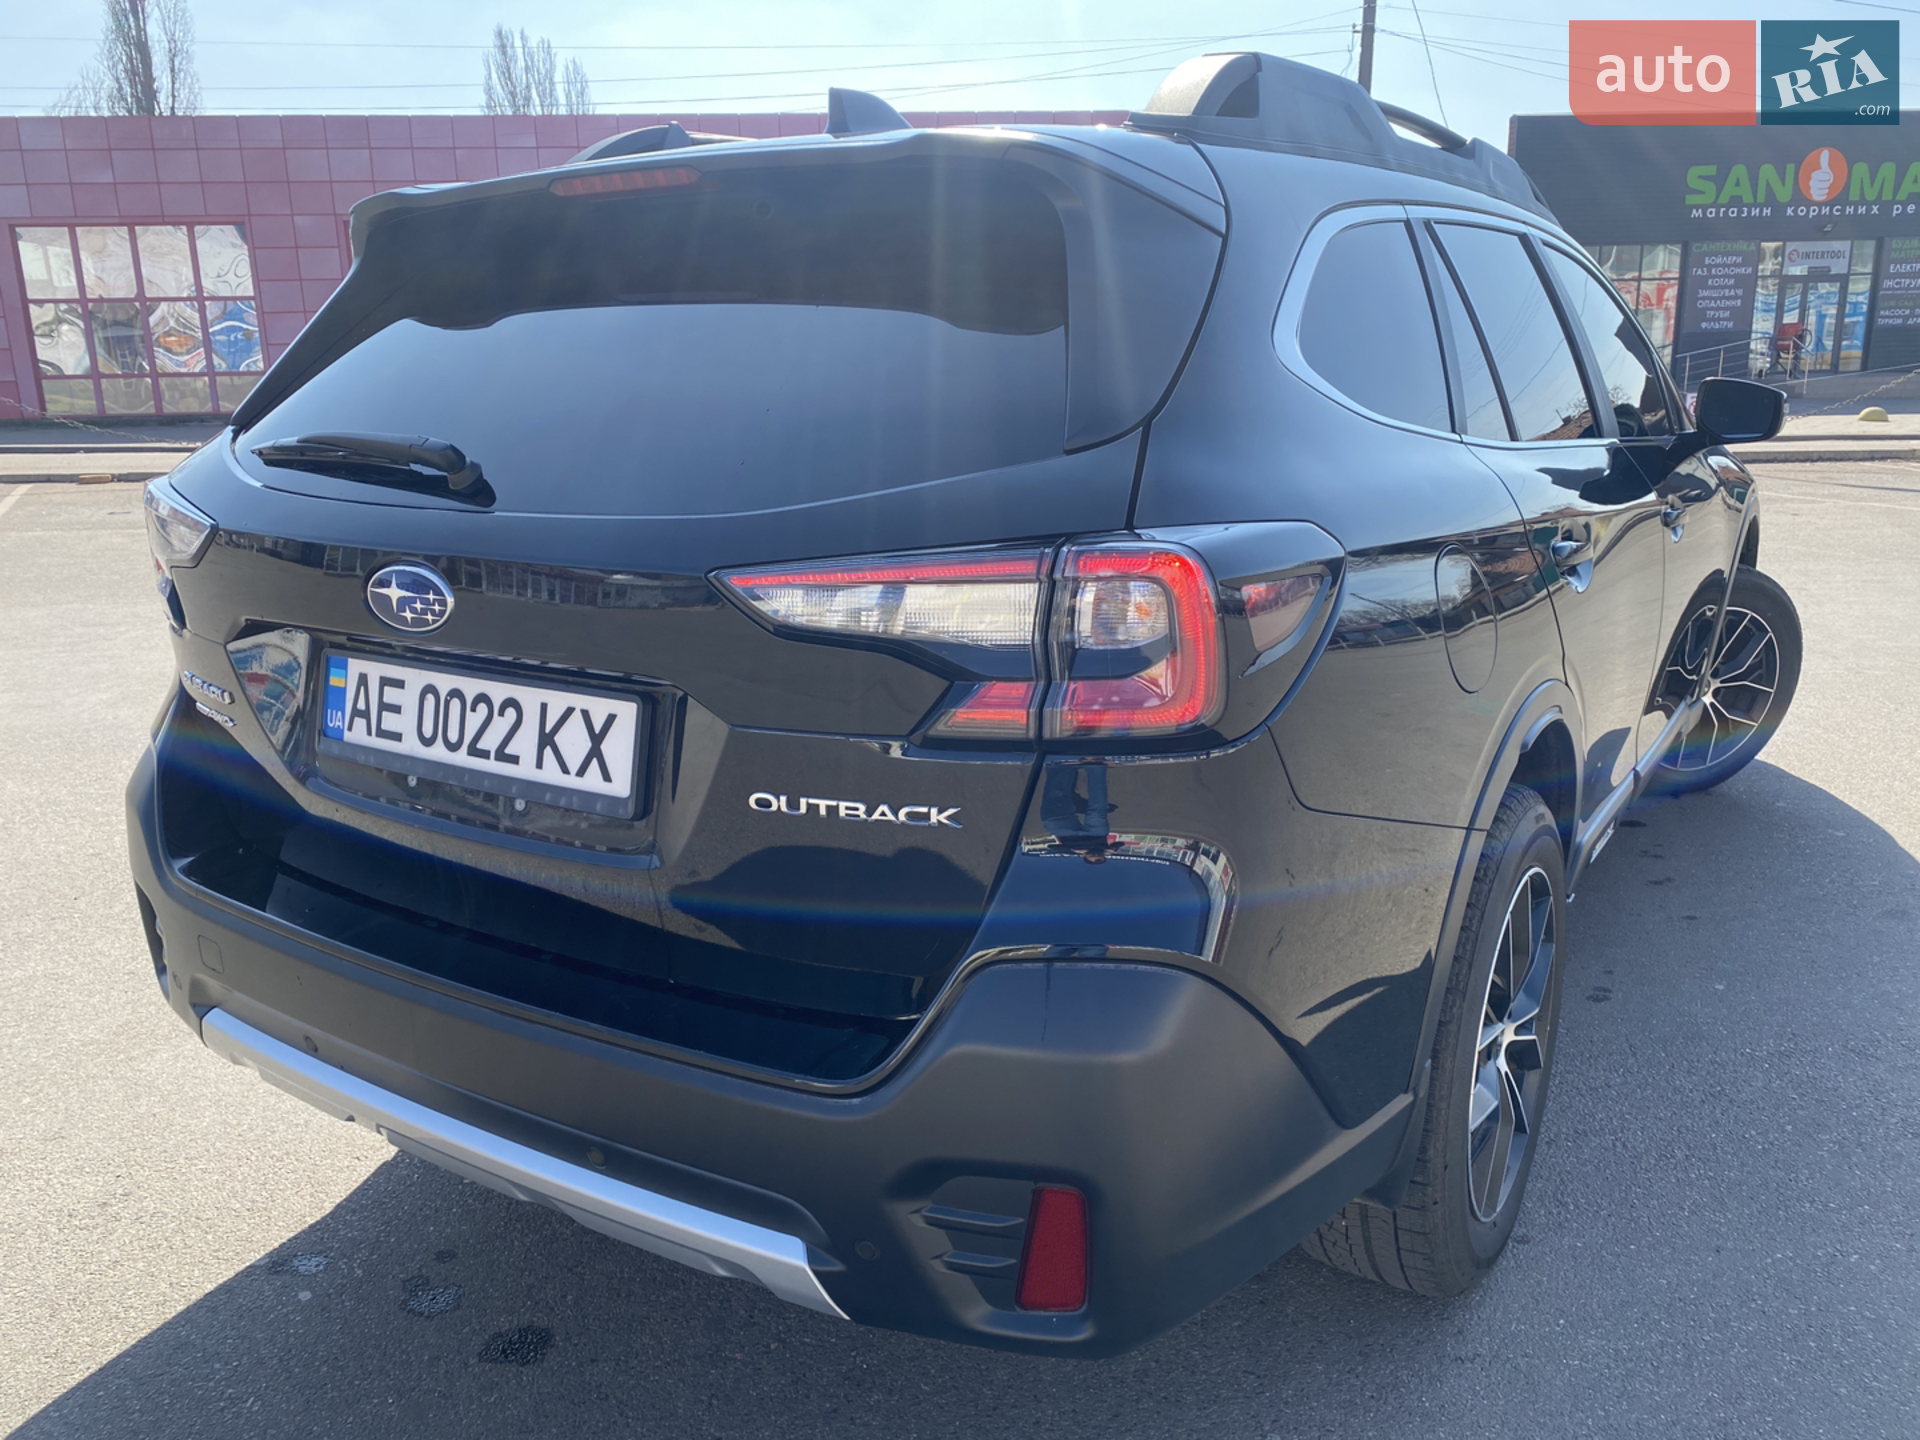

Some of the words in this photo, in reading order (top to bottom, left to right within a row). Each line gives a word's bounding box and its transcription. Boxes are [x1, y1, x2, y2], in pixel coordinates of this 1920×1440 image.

[1690, 205, 1773, 219] магазин
[1786, 203, 1881, 219] корисних
[1692, 242, 1756, 252] САНТЕХНІКА
[1704, 254, 1743, 265] БОЙЛЕРИ
[1800, 250, 1847, 260] INTERTOOL
[1711, 266, 1753, 275] КОЛОНКИ
[1707, 278, 1735, 286] КОТЛИ
[1697, 288, 1744, 297] ЗМІШУВАЧІ
[1696, 299, 1742, 308] ОПАЛЕННЯ
[1706, 310, 1731, 318] ТРУБИ
[1700, 321, 1734, 329] ФІЛЬТРИ
[327, 708, 344, 730] UA
[346, 671, 406, 743] AE
[416, 683, 524, 766] 0022
[535, 701, 618, 784] KX
[748, 791, 964, 829] OUTBACK
